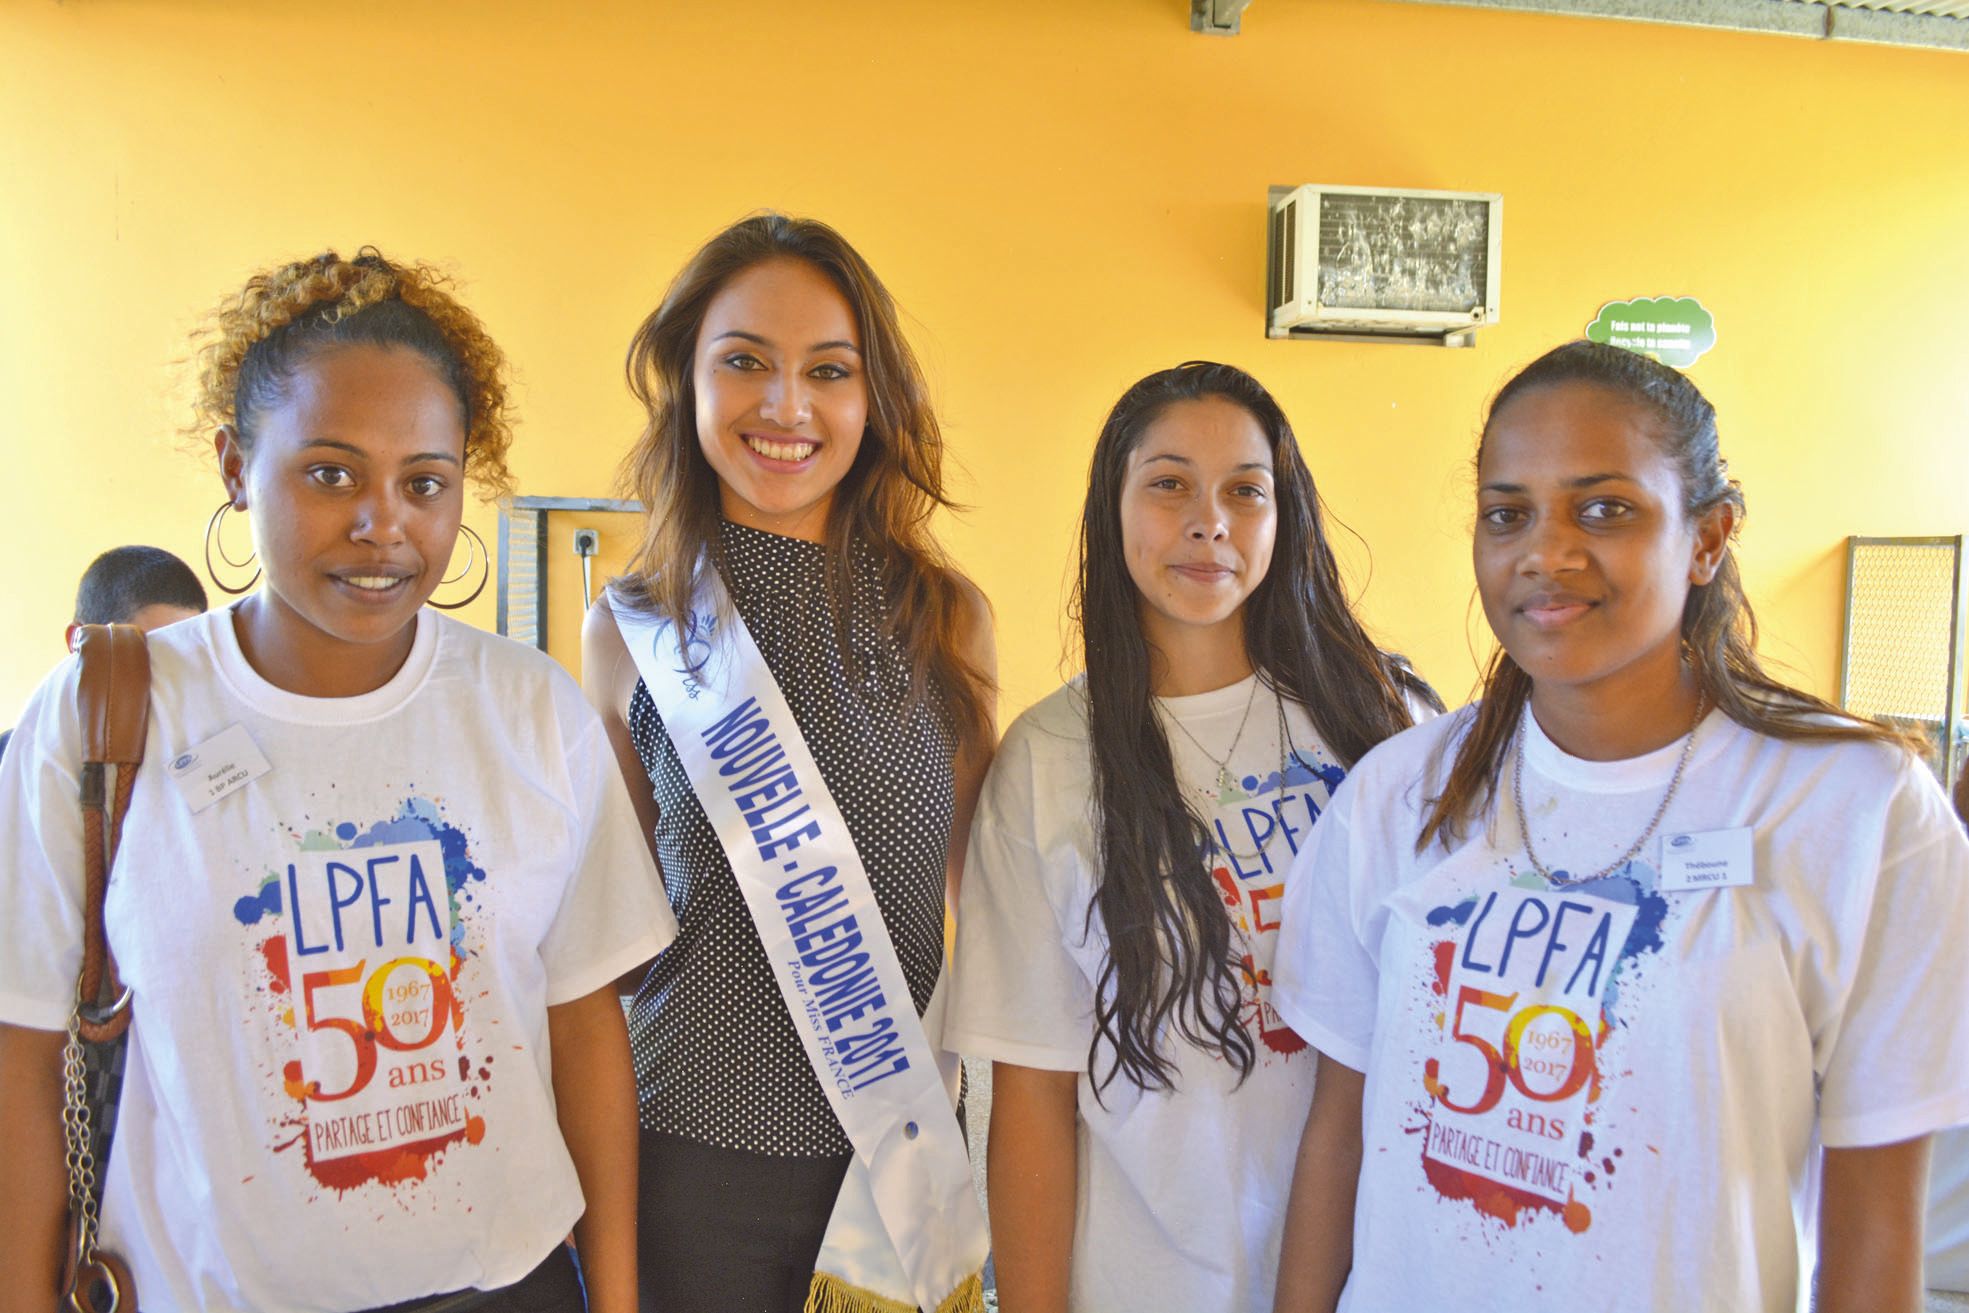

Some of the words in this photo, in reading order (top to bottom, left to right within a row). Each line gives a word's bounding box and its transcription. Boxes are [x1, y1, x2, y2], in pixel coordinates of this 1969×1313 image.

[288, 853, 443, 957] LPFA
[701, 696, 822, 862] NOUVELLE
[775, 865, 887, 1034] CALEDONIE
[834, 1016, 911, 1092] 2017
[1461, 891, 1611, 997] LPFA
[386, 981, 430, 1003] 1967
[391, 1006, 429, 1029] 2017
[302, 957, 451, 1102] 50
[788, 960, 808, 996] Pour
[803, 998, 823, 1033] Miss
[818, 1035, 855, 1101] FRANCE
[1424, 985, 1595, 1115] 50
[1527, 1030, 1572, 1053] 1967
[388, 1055, 446, 1089] ans
[1523, 1058, 1568, 1081] 2017
[315, 1115, 374, 1153] PARTAGE
[378, 1112, 393, 1143] ET
[396, 1095, 462, 1138] CONFIANCE
[1507, 1108, 1565, 1140] ans
[1431, 1122, 1483, 1168] PARTAGE
[1484, 1145, 1501, 1170] ET
[1503, 1148, 1569, 1194] CONFIANCE
